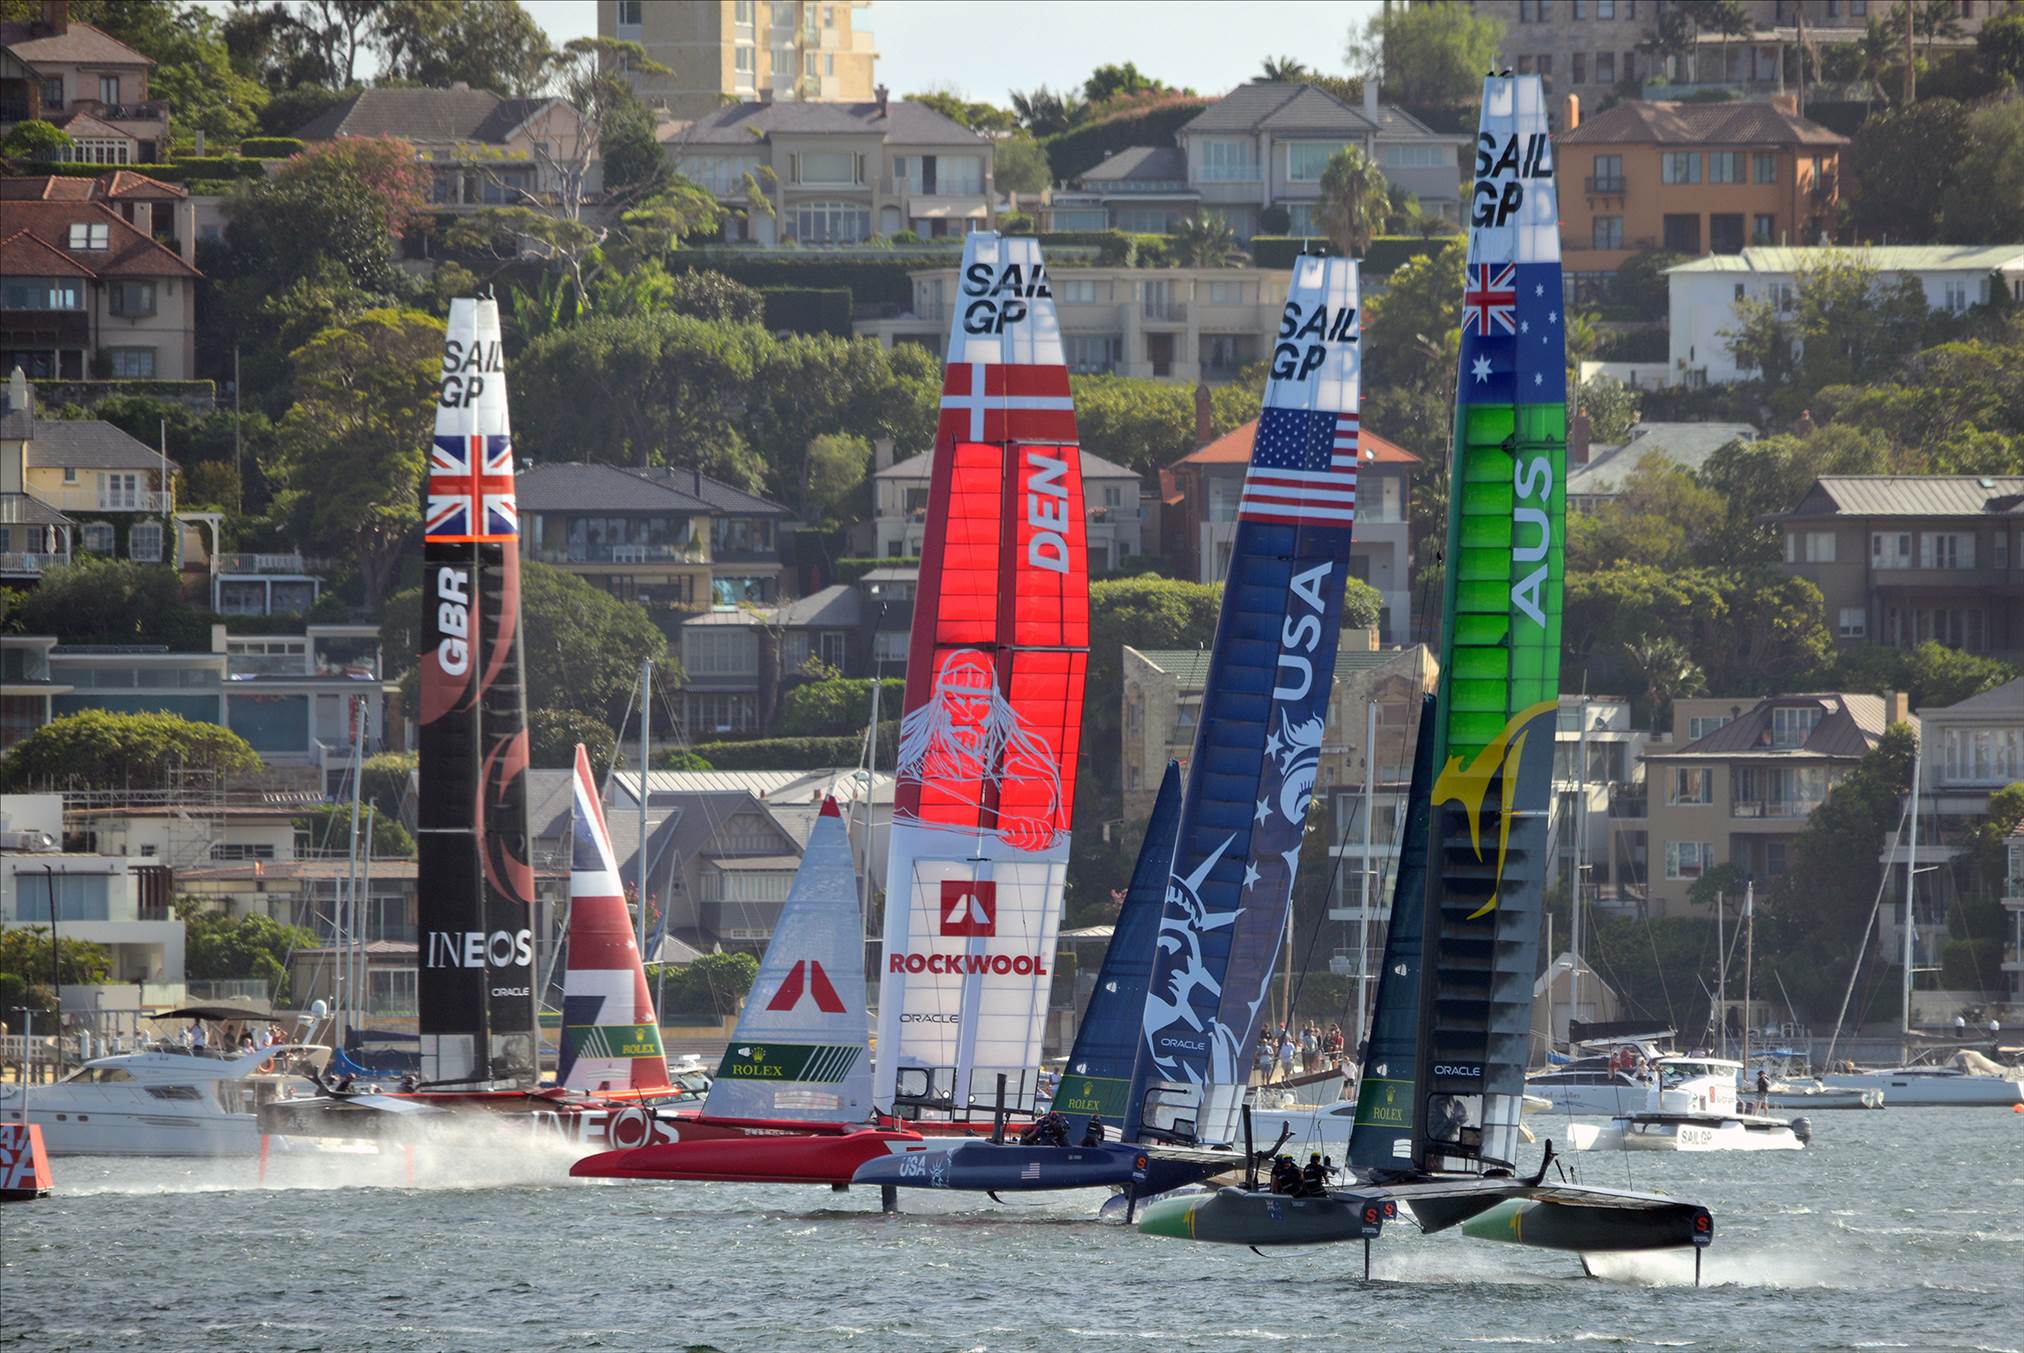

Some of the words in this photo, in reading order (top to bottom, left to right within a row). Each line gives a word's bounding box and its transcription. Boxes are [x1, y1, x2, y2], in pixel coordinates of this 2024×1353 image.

[1475, 132, 1553, 179] SAIL
[1471, 180, 1524, 228] GP
[962, 263, 1053, 298] SAIL
[962, 300, 1027, 335] GP
[1279, 301, 1359, 343] SAIL
[442, 340, 504, 374] SAIL
[1270, 342, 1327, 382] GP
[438, 375, 484, 409] GP
[1027, 453, 1069, 574] DEN
[1511, 456, 1552, 629] AUS
[438, 566, 468, 677] GBR
[1273, 561, 1334, 702] USA
[426, 929, 532, 968] INEOS
[890, 953, 1047, 976] ROCKWOOL
[491, 987, 530, 997] ORACLE
[899, 1013, 959, 1024] ORACLE
[623, 1043, 655, 1054] ROLEX
[1160, 1037, 1206, 1051] ORACLE
[732, 1063, 783, 1077] ROLEX
[1434, 1065, 1481, 1077] ORACLE
[1068, 1098, 1100, 1111] ROLEX
[1373, 1107, 1403, 1121] ROLEX
[899, 1155, 926, 1177] USA
